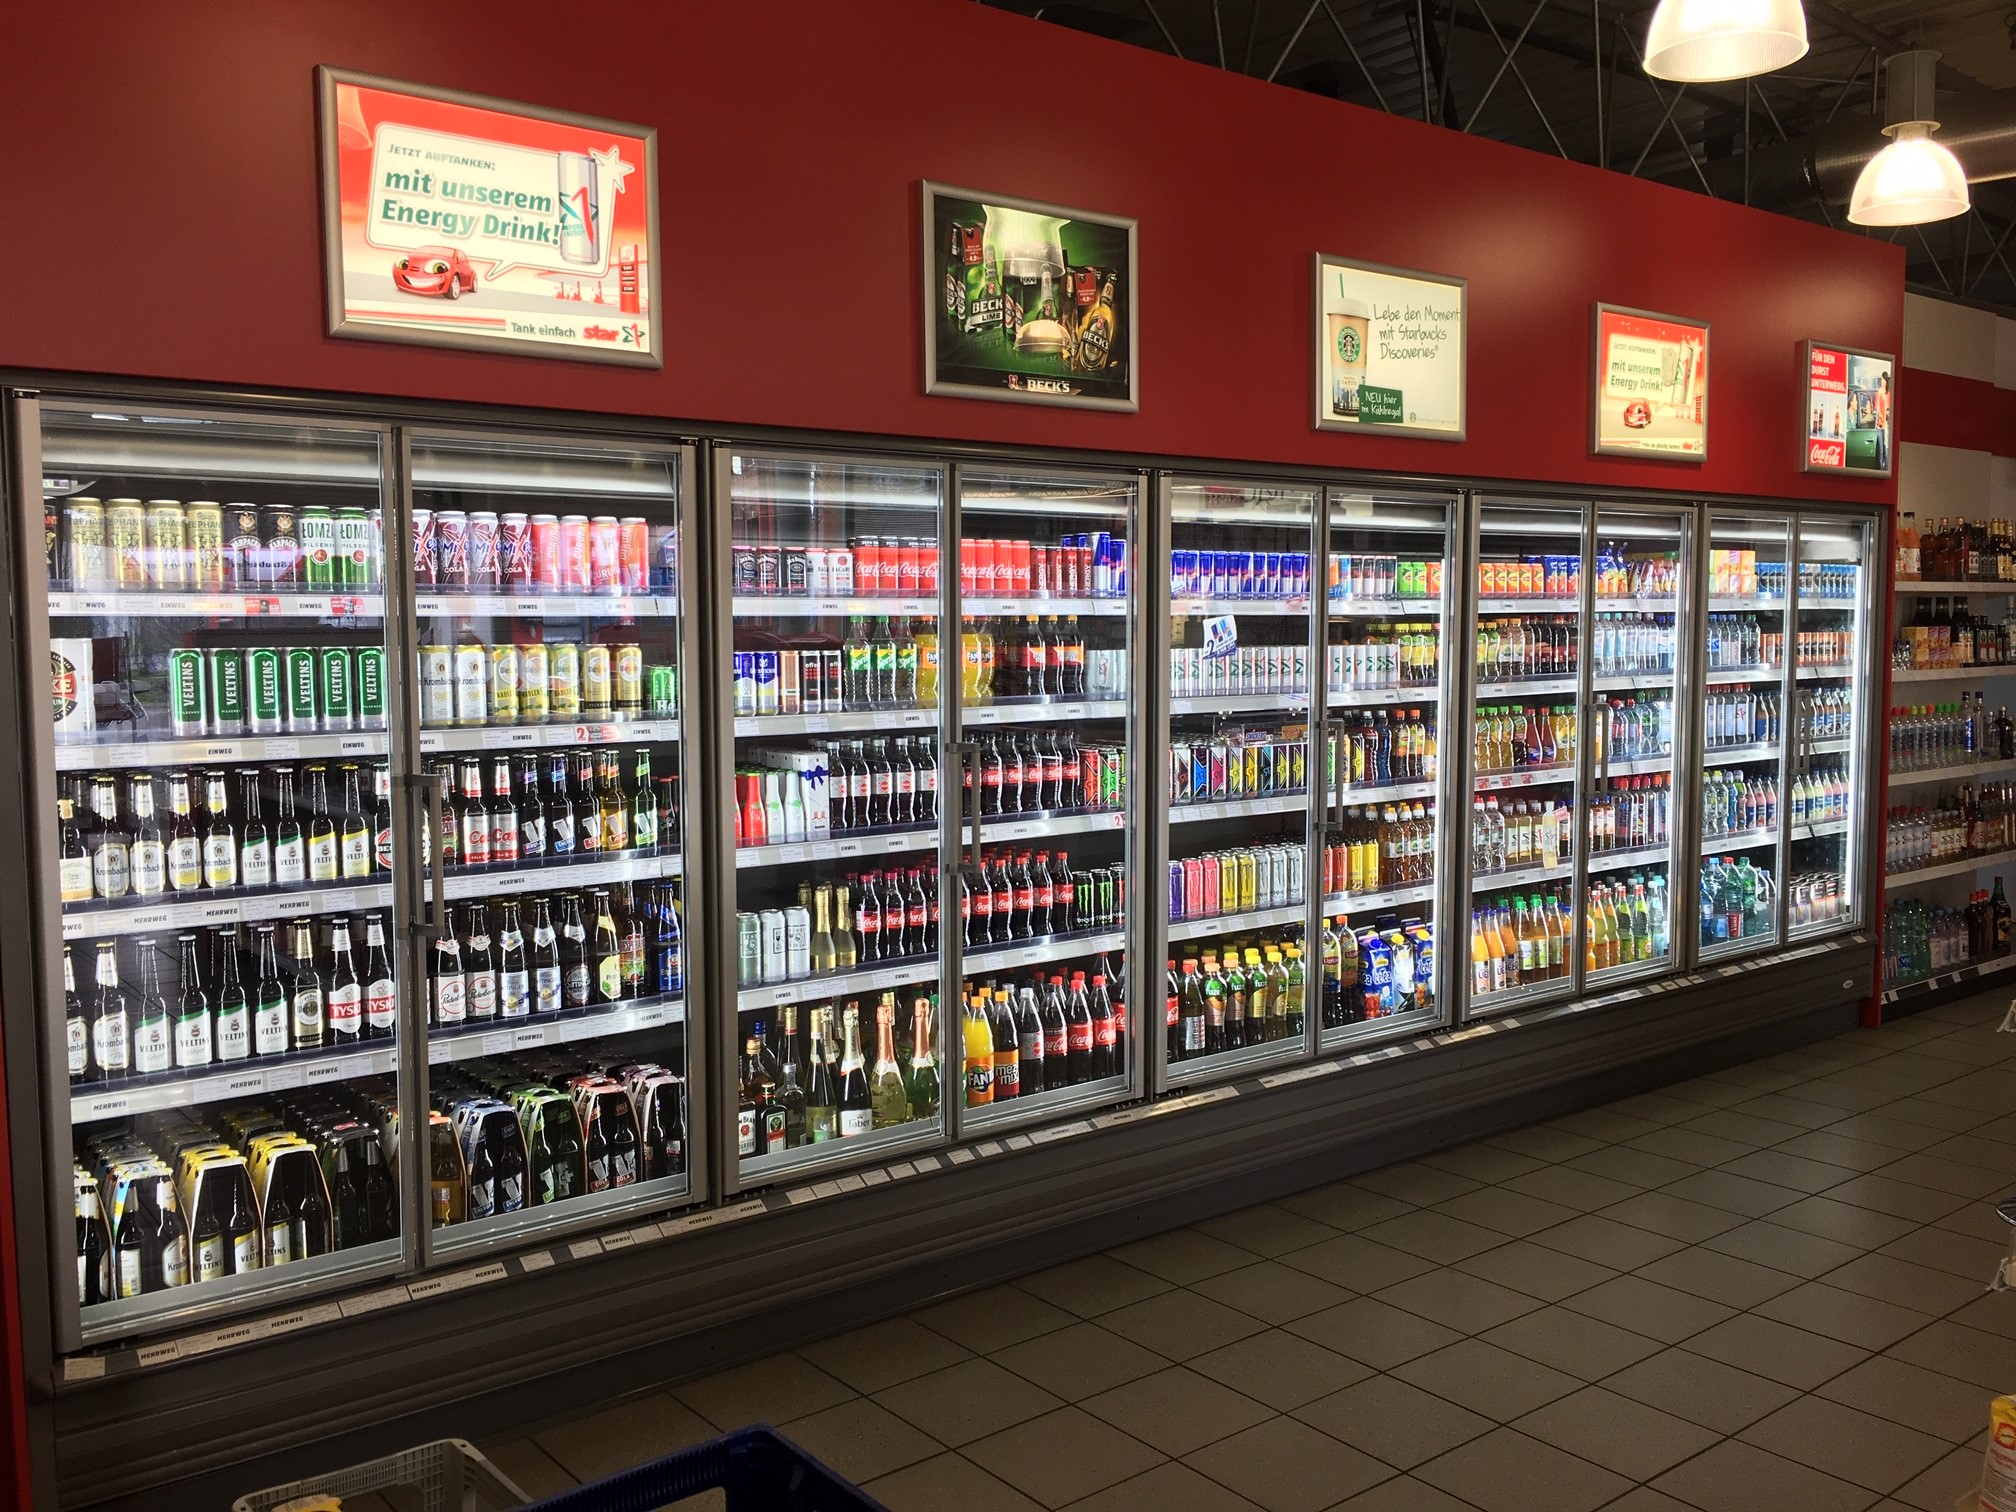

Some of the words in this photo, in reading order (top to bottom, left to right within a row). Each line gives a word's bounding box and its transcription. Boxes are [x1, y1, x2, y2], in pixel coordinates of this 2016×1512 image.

[385, 169, 432, 194] mit
[441, 179, 552, 213] unserem
[382, 199, 476, 236] Energy
[482, 213, 560, 245] Drink!
[981, 313, 1001, 322] LIME
[1373, 304, 1400, 321] Lebe
[1404, 307, 1421, 322] den
[1424, 305, 1460, 322] Moment
[511, 322, 535, 335] Tank
[538, 324, 576, 338] einfach
[582, 324, 619, 342] star
[1379, 323, 1394, 340] mit
[1398, 324, 1446, 341] Starbucks
[1812, 351, 1823, 363] FÜR
[1824, 354, 1835, 364] DEN
[1612, 360, 1626, 371] mit
[1628, 363, 1661, 376] unserem
[1812, 366, 1829, 376] DURST
[1611, 375, 1639, 390] Energy
[1640, 380, 1663, 392] Drink!
[1365, 391, 1382, 403] NEU
[1383, 393, 1398, 405] hier
[1361, 402, 1369, 414] im
[182, 661, 194, 707] VELTINS
[225, 661, 237, 706] VELTINS
[262, 659, 275, 705] VELTINS
[299, 659, 311, 704] VELTINS
[331, 659, 343, 703] VELTINS
[366, 658, 376, 701] VELTINS
[499, 878, 525, 886] MEHRWEG
[279, 901, 310, 909] MEHRWEG
[206, 908, 238, 917] MEHRWEG
[134, 915, 167, 924] MEHRWEG
[517, 1033, 543, 1041] MEHRWEG
[309, 1067, 338, 1077] MEHRWEG
[230, 1079, 261, 1089] MEHRWEG
[93, 1101, 127, 1111] MEHRWEG
[739, 1203, 765, 1213] MEHRWEG
[688, 1215, 713, 1226] MEHRWEG
[604, 1235, 631, 1246] MEHRWEG
[475, 1266, 505, 1279] MEHRWEG
[411, 1282, 442, 1294] MEHRWEG
[271, 1316, 304, 1328] MEHRWEG
[217, 1329, 251, 1341] MEHRWEG
[141, 1347, 176, 1360] MEHRWEG
